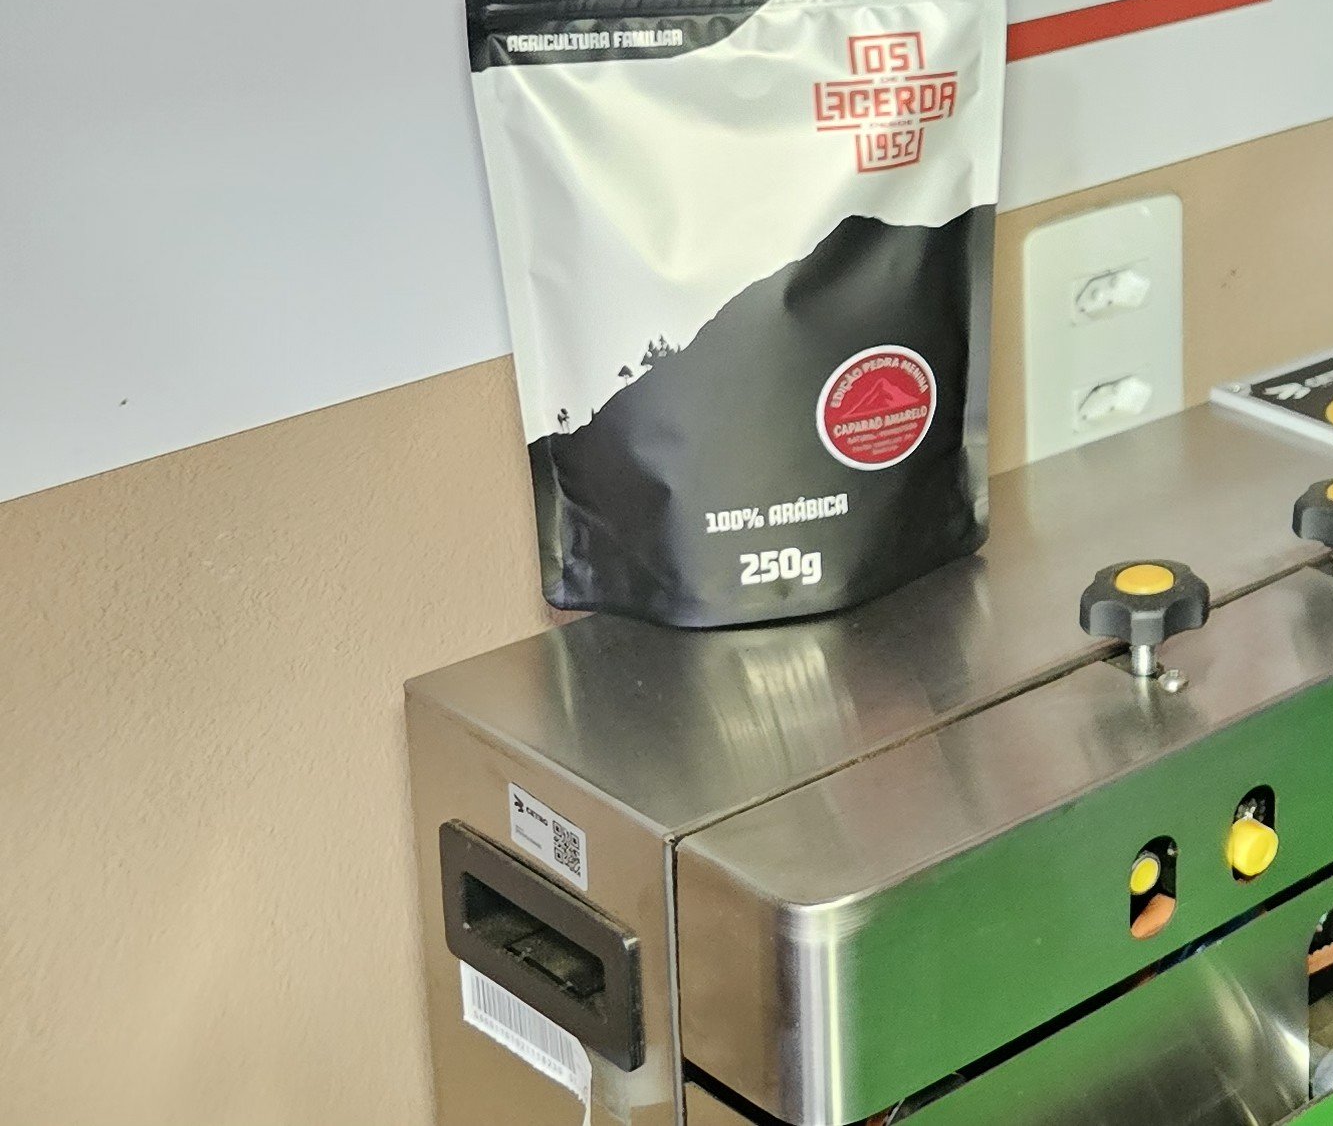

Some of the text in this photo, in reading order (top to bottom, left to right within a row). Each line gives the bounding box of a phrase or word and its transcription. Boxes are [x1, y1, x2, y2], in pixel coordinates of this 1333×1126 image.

[506, 28, 683, 53] AGRICULTURA FAMILIAR
[862, 42, 910, 74] OS
[866, 130, 917, 162] 1952
[861, 357, 899, 374] PEDRA
[900, 359, 929, 394] MENINA
[884, 405, 928, 427] AMARELO
[705, 493, 849, 534] 100% ARÁBICA
[739, 547, 823, 585] 250g
